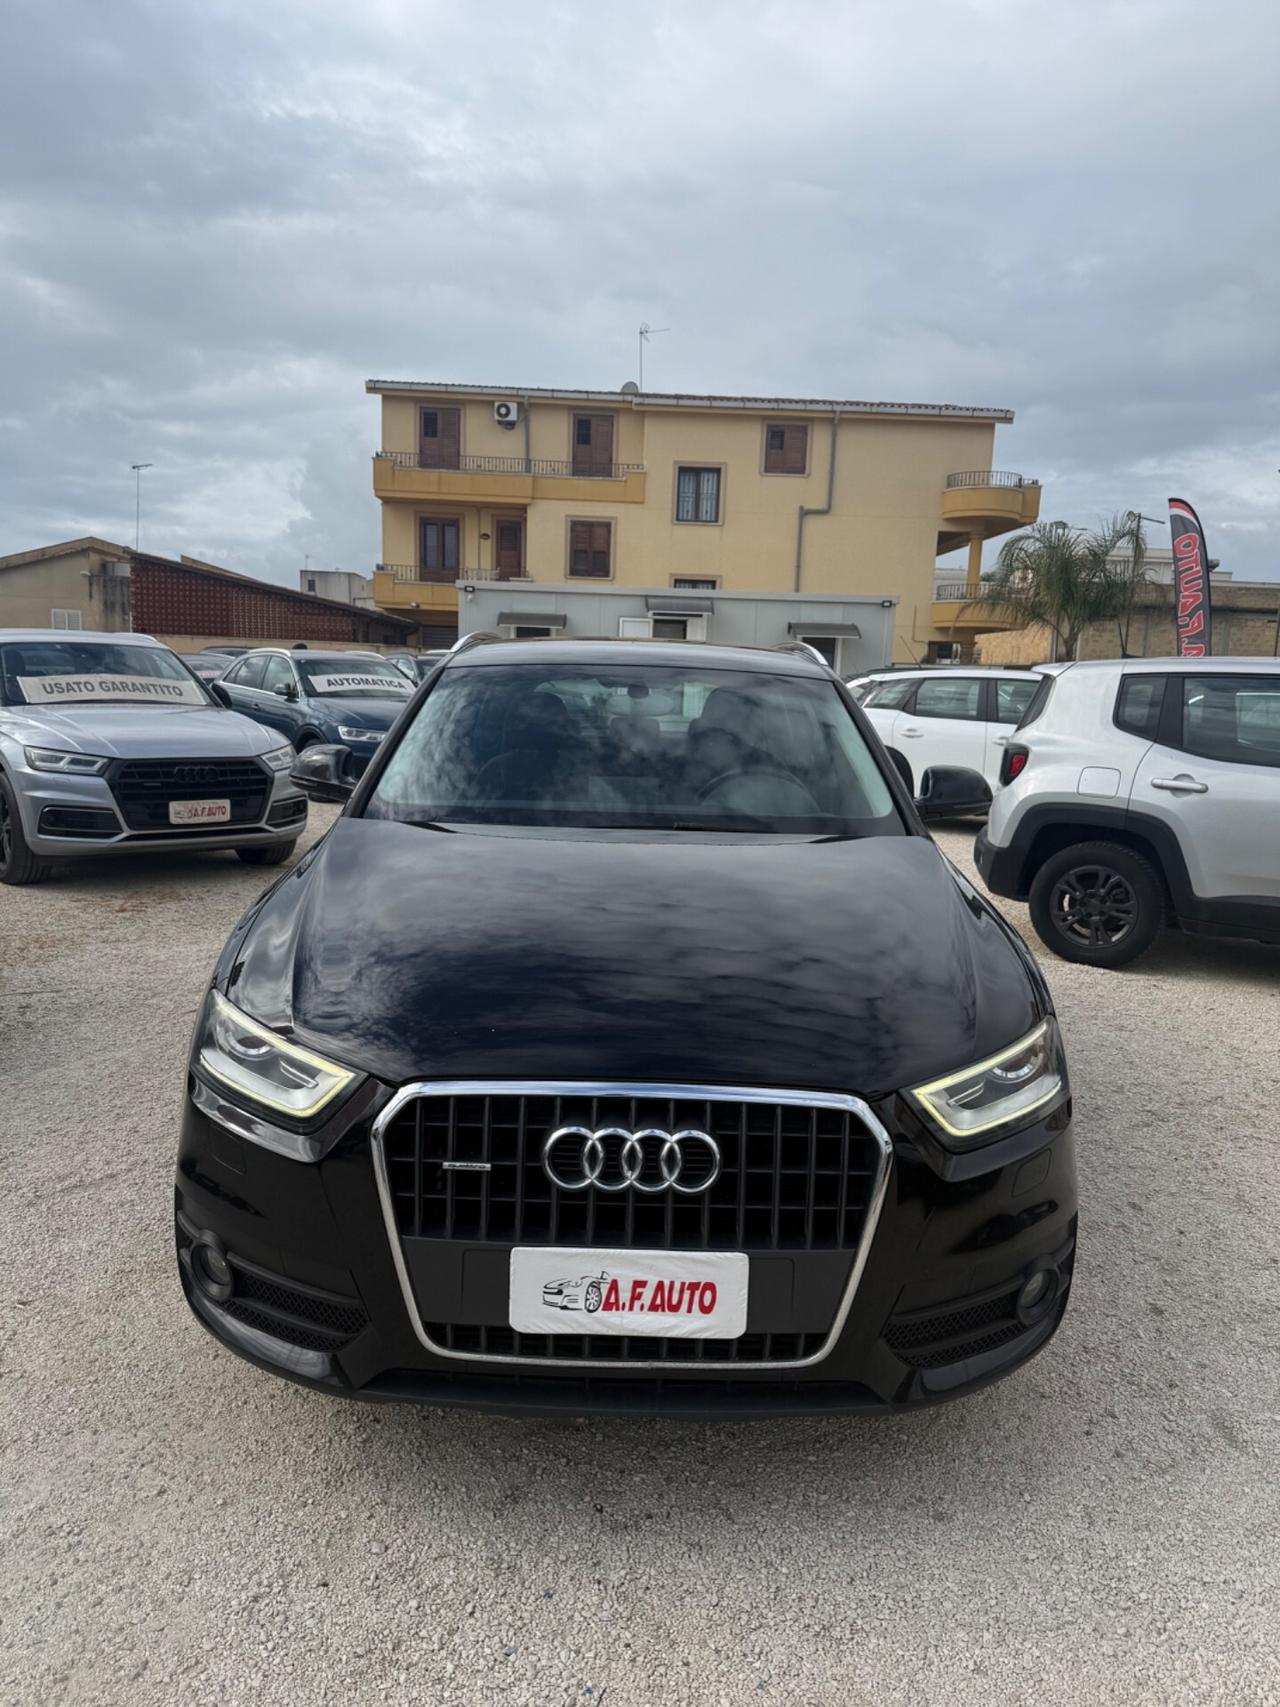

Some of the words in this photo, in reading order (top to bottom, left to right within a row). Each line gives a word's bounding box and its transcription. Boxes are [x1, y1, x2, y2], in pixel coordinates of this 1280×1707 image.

[41, 681, 95, 695] USATO
[99, 681, 183, 697] GARANTITO
[327, 678, 407, 690] AUTOMATICA
